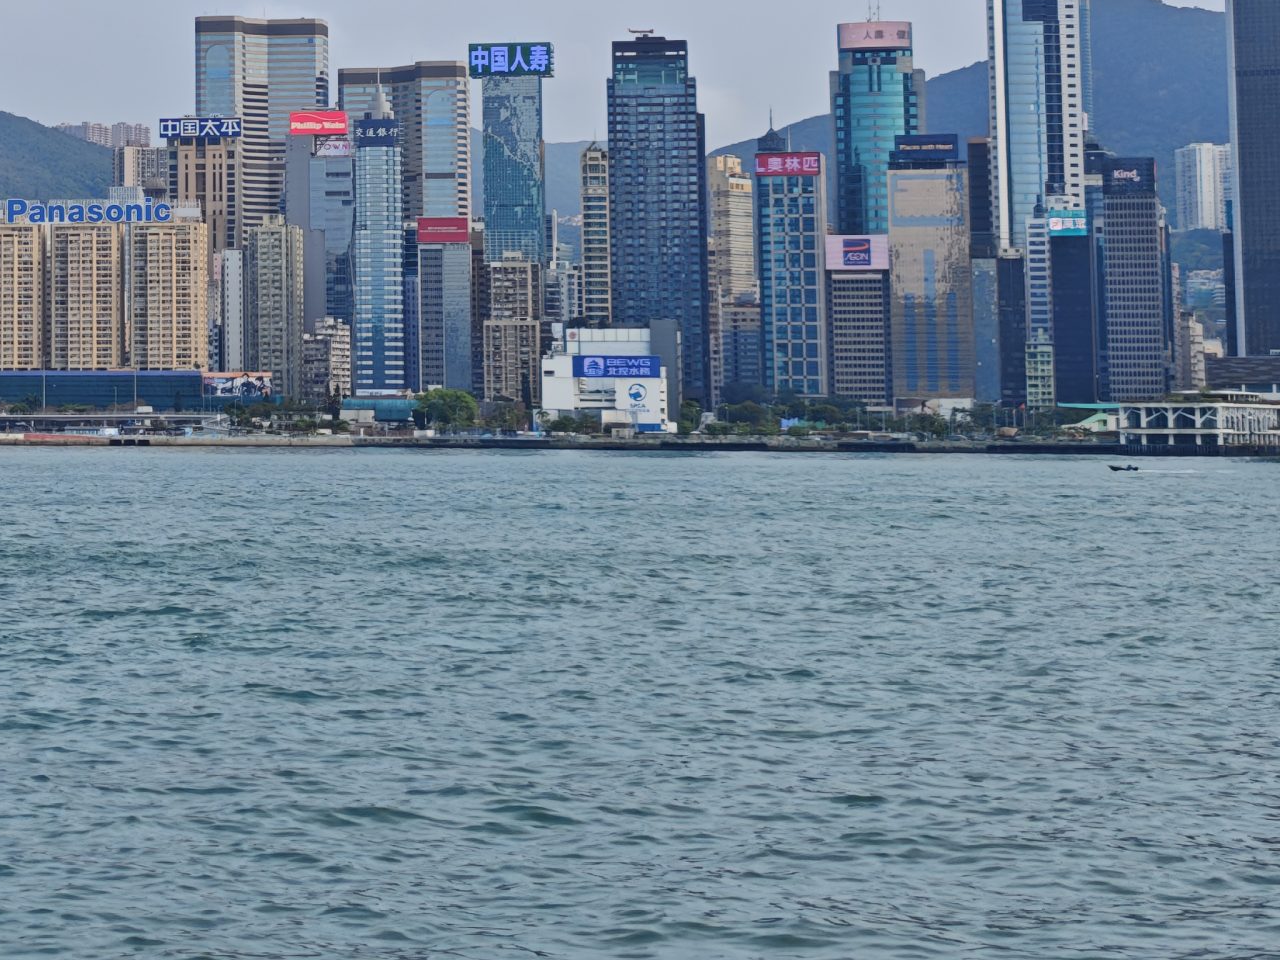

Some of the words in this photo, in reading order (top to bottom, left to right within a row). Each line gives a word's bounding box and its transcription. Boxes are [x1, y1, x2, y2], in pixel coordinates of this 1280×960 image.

[470, 44, 549, 73] 中国人寿
[160, 119, 240, 137] 中国太平
[355, 127, 399, 137] 交通銀行
[6, 196, 172, 223] Panasonic
[606, 358, 651, 366] BEWG
